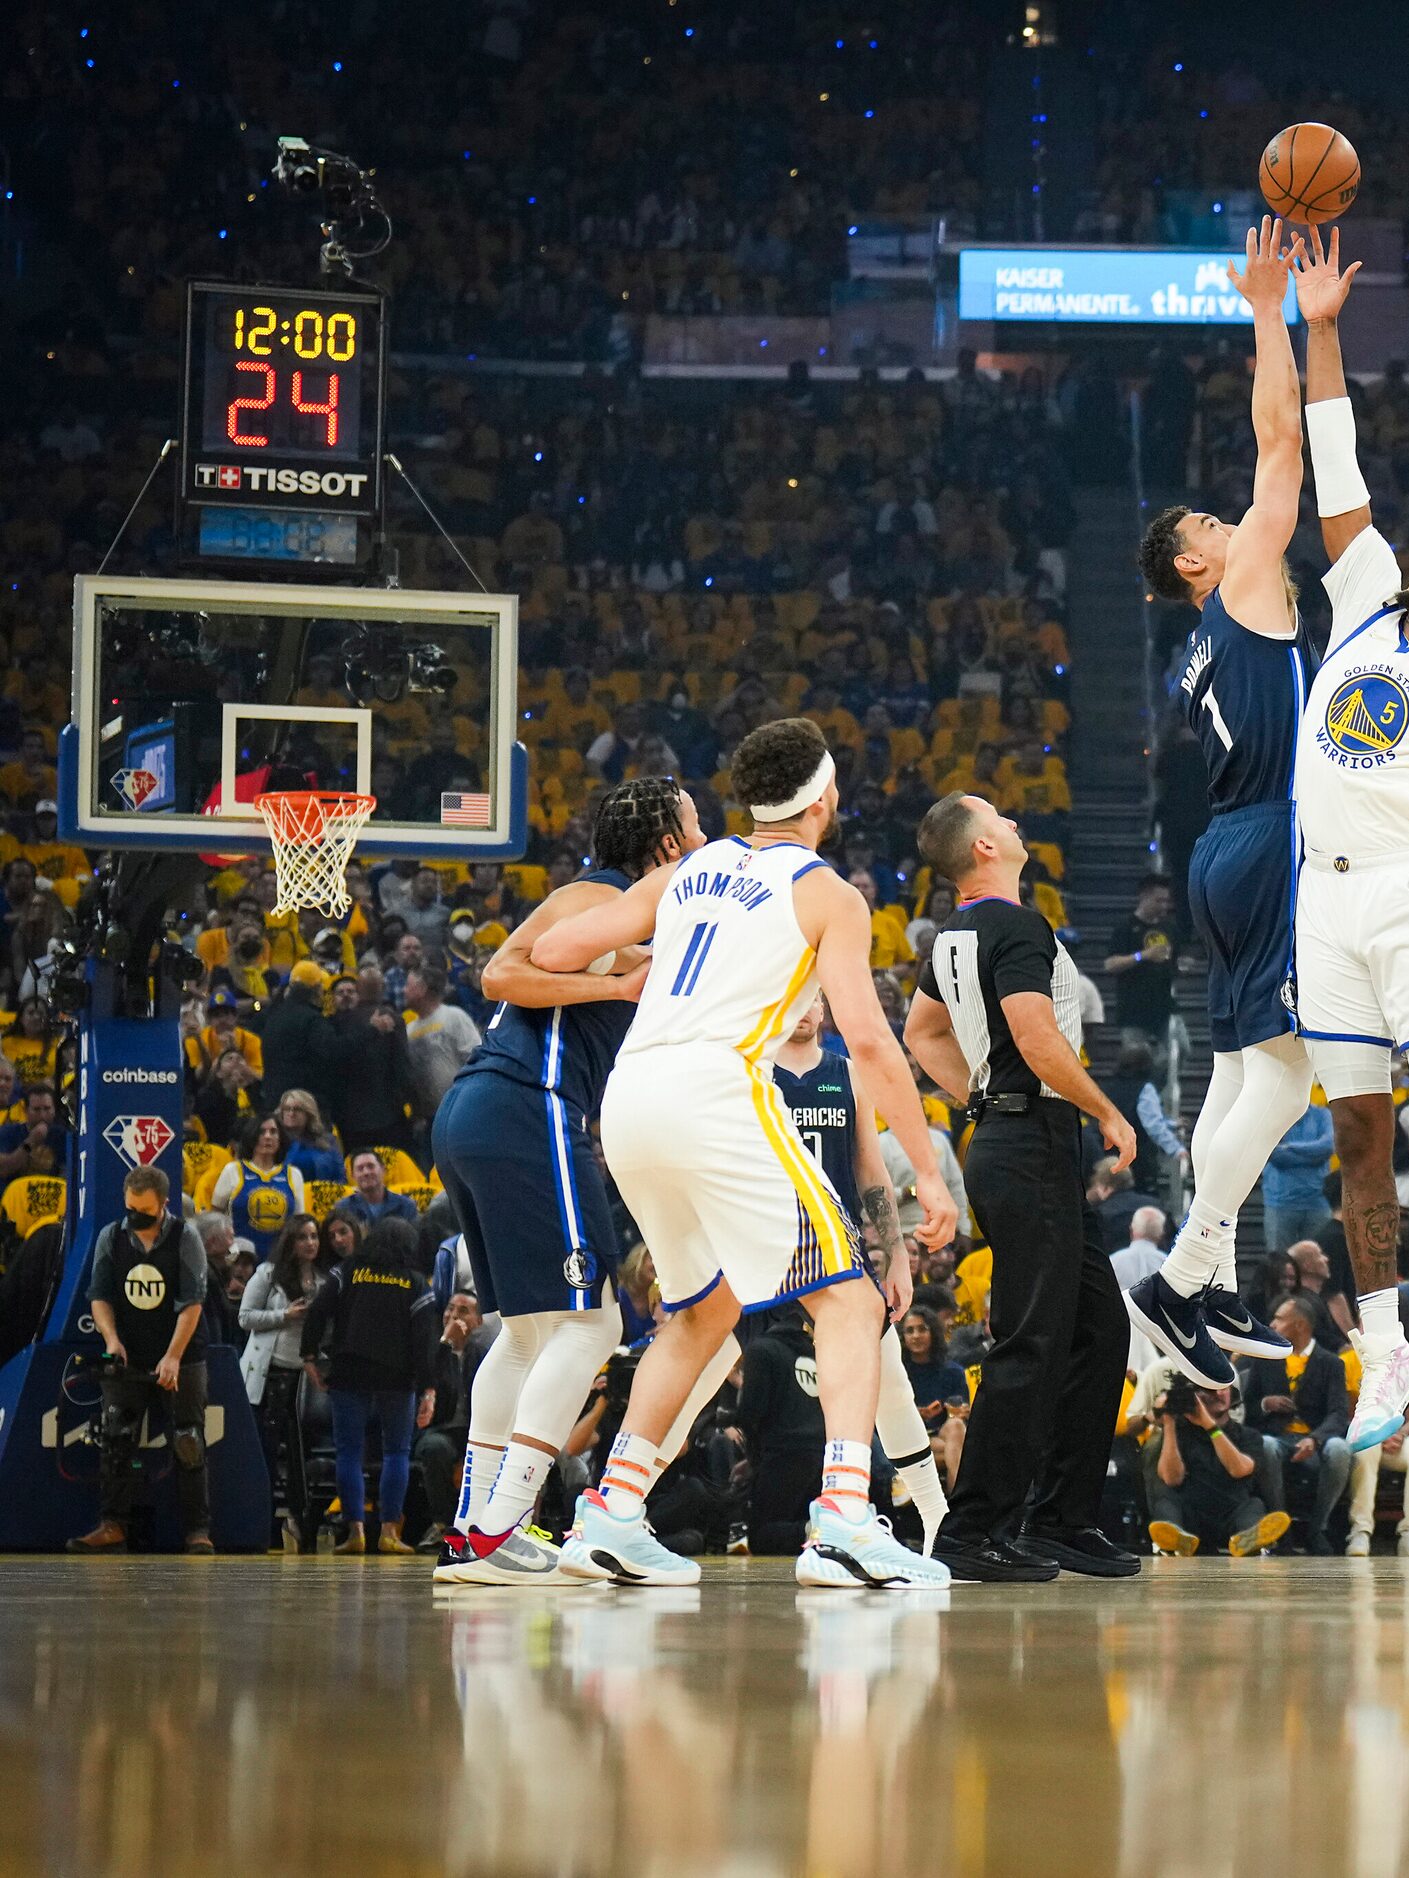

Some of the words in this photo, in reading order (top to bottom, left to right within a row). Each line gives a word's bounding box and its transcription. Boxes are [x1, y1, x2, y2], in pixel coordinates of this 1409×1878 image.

[996, 267, 1063, 289] KAISER
[235, 307, 356, 361] 12:00
[227, 361, 339, 447] 24
[243, 466, 369, 498] TISSOT
[1344, 663, 1394, 678] GOLDEN
[1200, 682, 1233, 753] 1
[1380, 701, 1399, 724] 5
[1315, 726, 1396, 769] WARRIORS
[672, 871, 773, 912] THOMPSON
[670, 921, 719, 997] 11
[102, 1067, 178, 1085] coinbase
[817, 1084, 842, 1093] chime
[789, 1107, 846, 1127] ERICKS
[145, 1125, 159, 1145] 75
[125, 1279, 165, 1297] TNT
[351, 1267, 412, 1289] Warriors
[795, 1368, 817, 1385] TN
